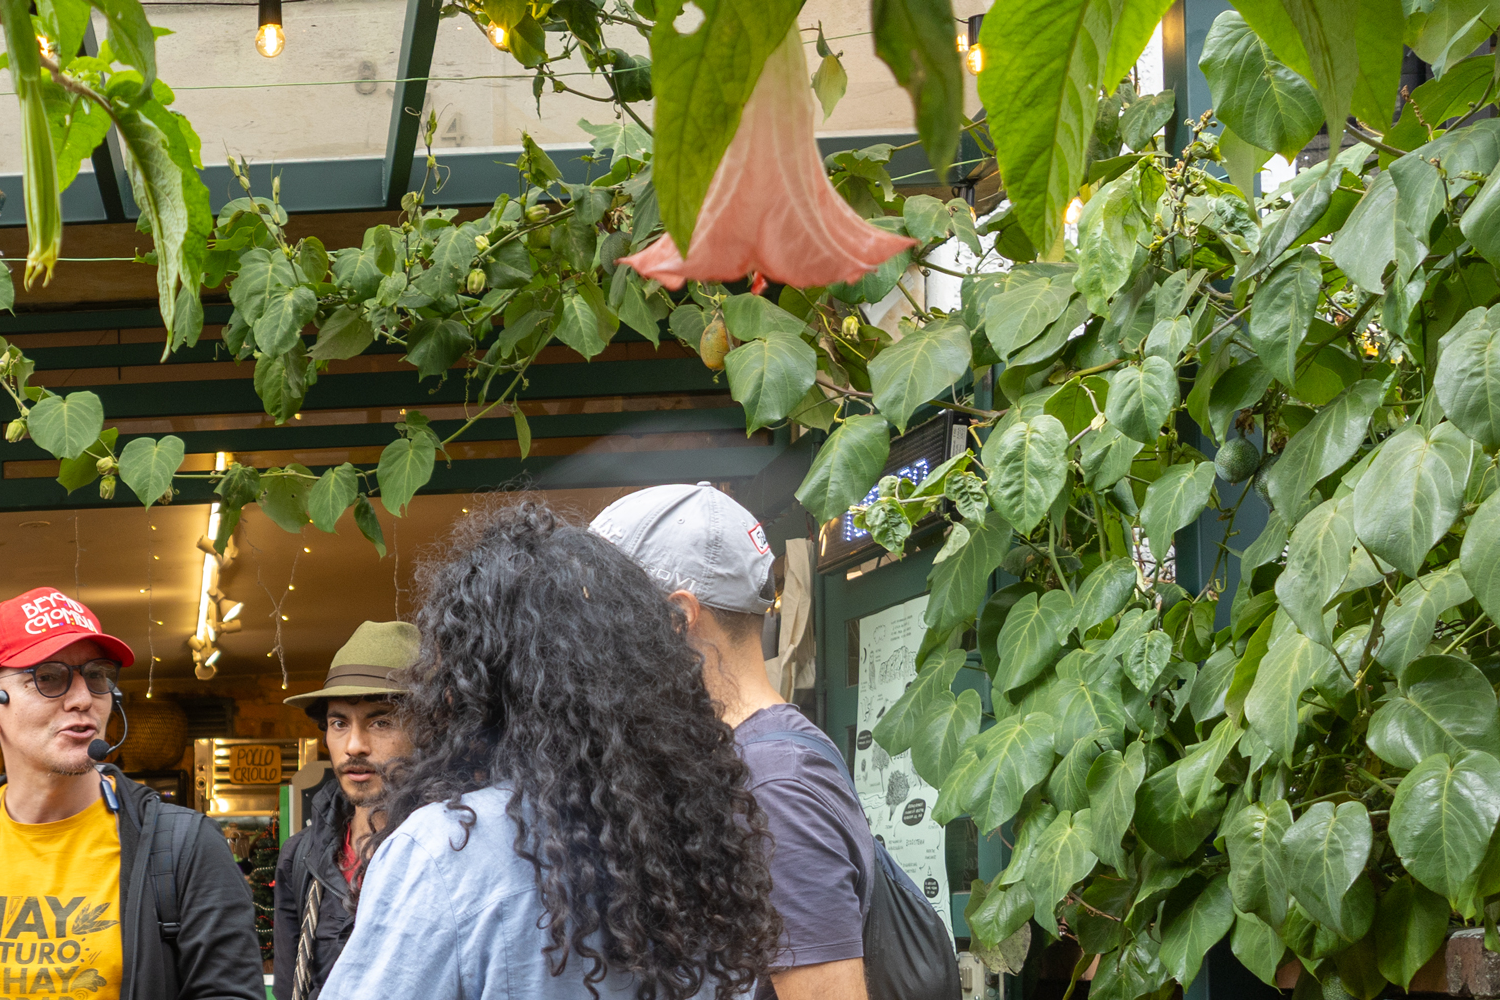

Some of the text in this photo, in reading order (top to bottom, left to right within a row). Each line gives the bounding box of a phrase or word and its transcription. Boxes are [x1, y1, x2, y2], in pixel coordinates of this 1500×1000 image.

[21, 592, 84, 619] BEYOND
[233, 766, 277, 782] CRIOLLO
[3, 965, 80, 995] HAY
